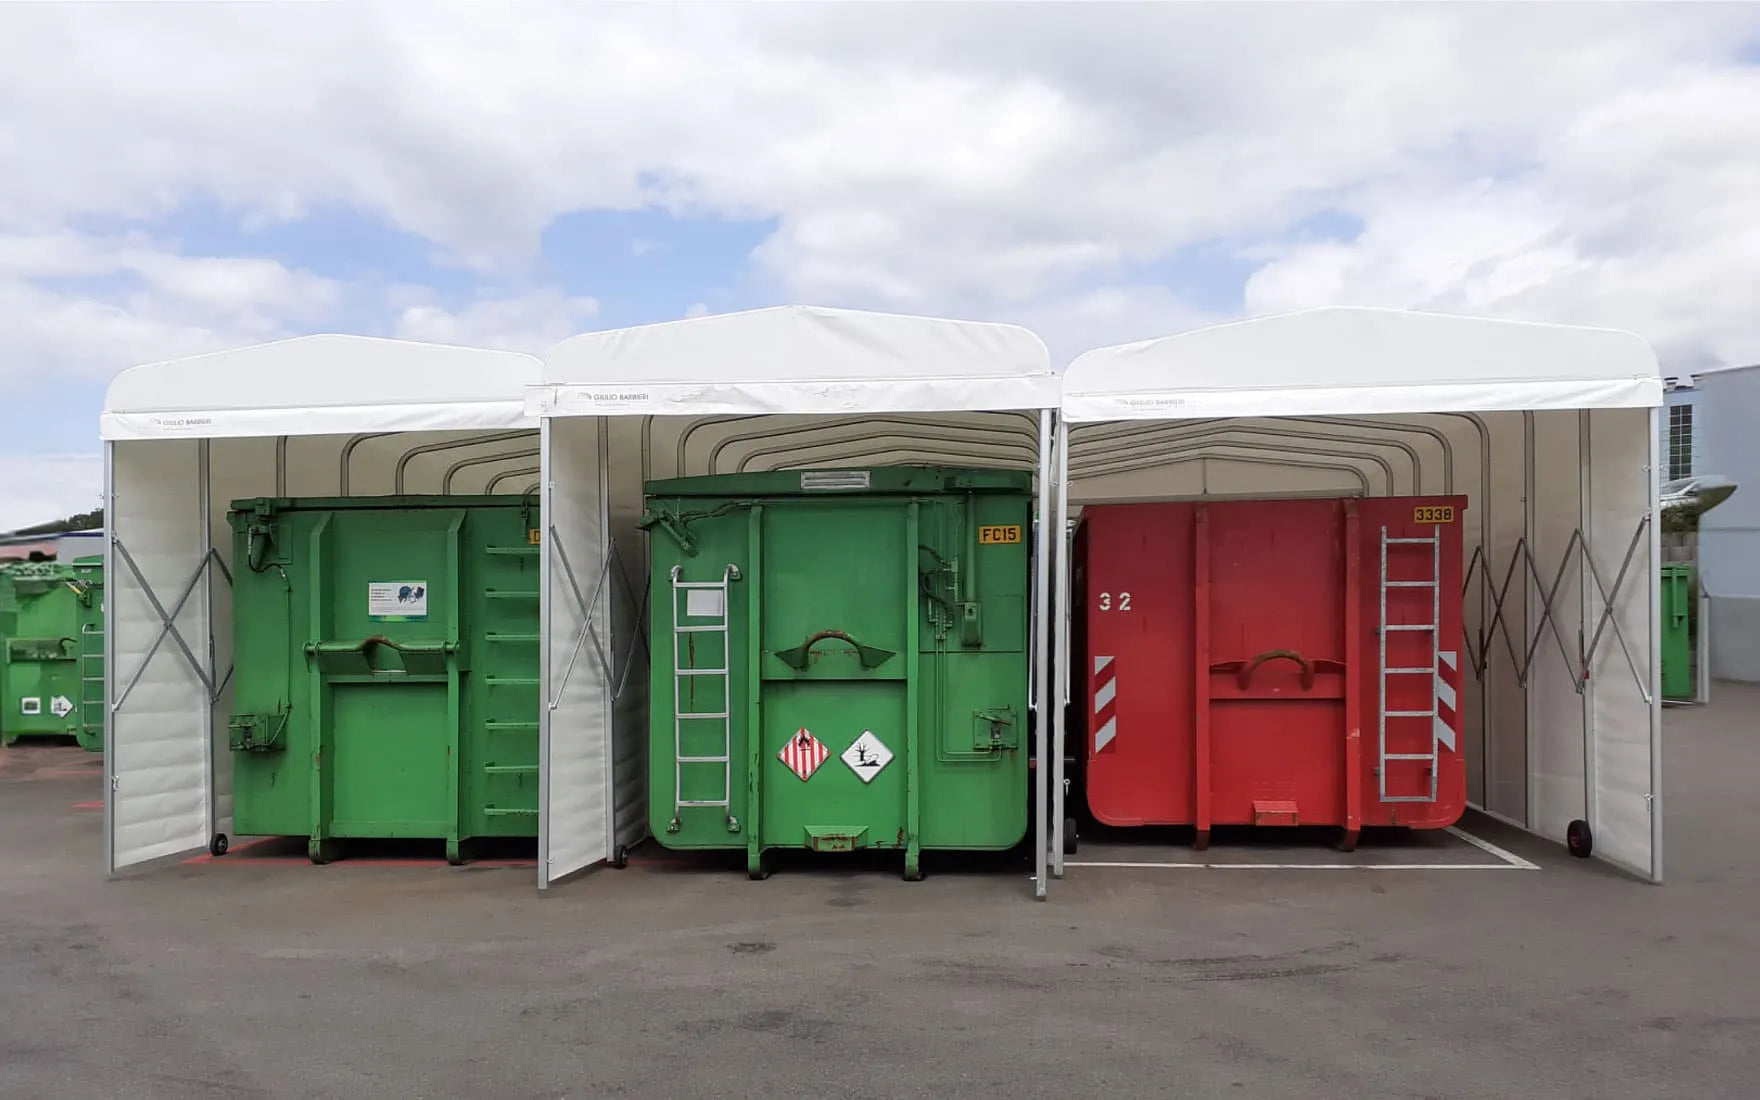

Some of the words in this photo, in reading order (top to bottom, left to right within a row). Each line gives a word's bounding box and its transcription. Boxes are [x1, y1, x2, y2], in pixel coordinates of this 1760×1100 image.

[594, 393, 618, 401] GIULIO
[1416, 508, 1452, 521] 3338
[982, 527, 1017, 541] FC15
